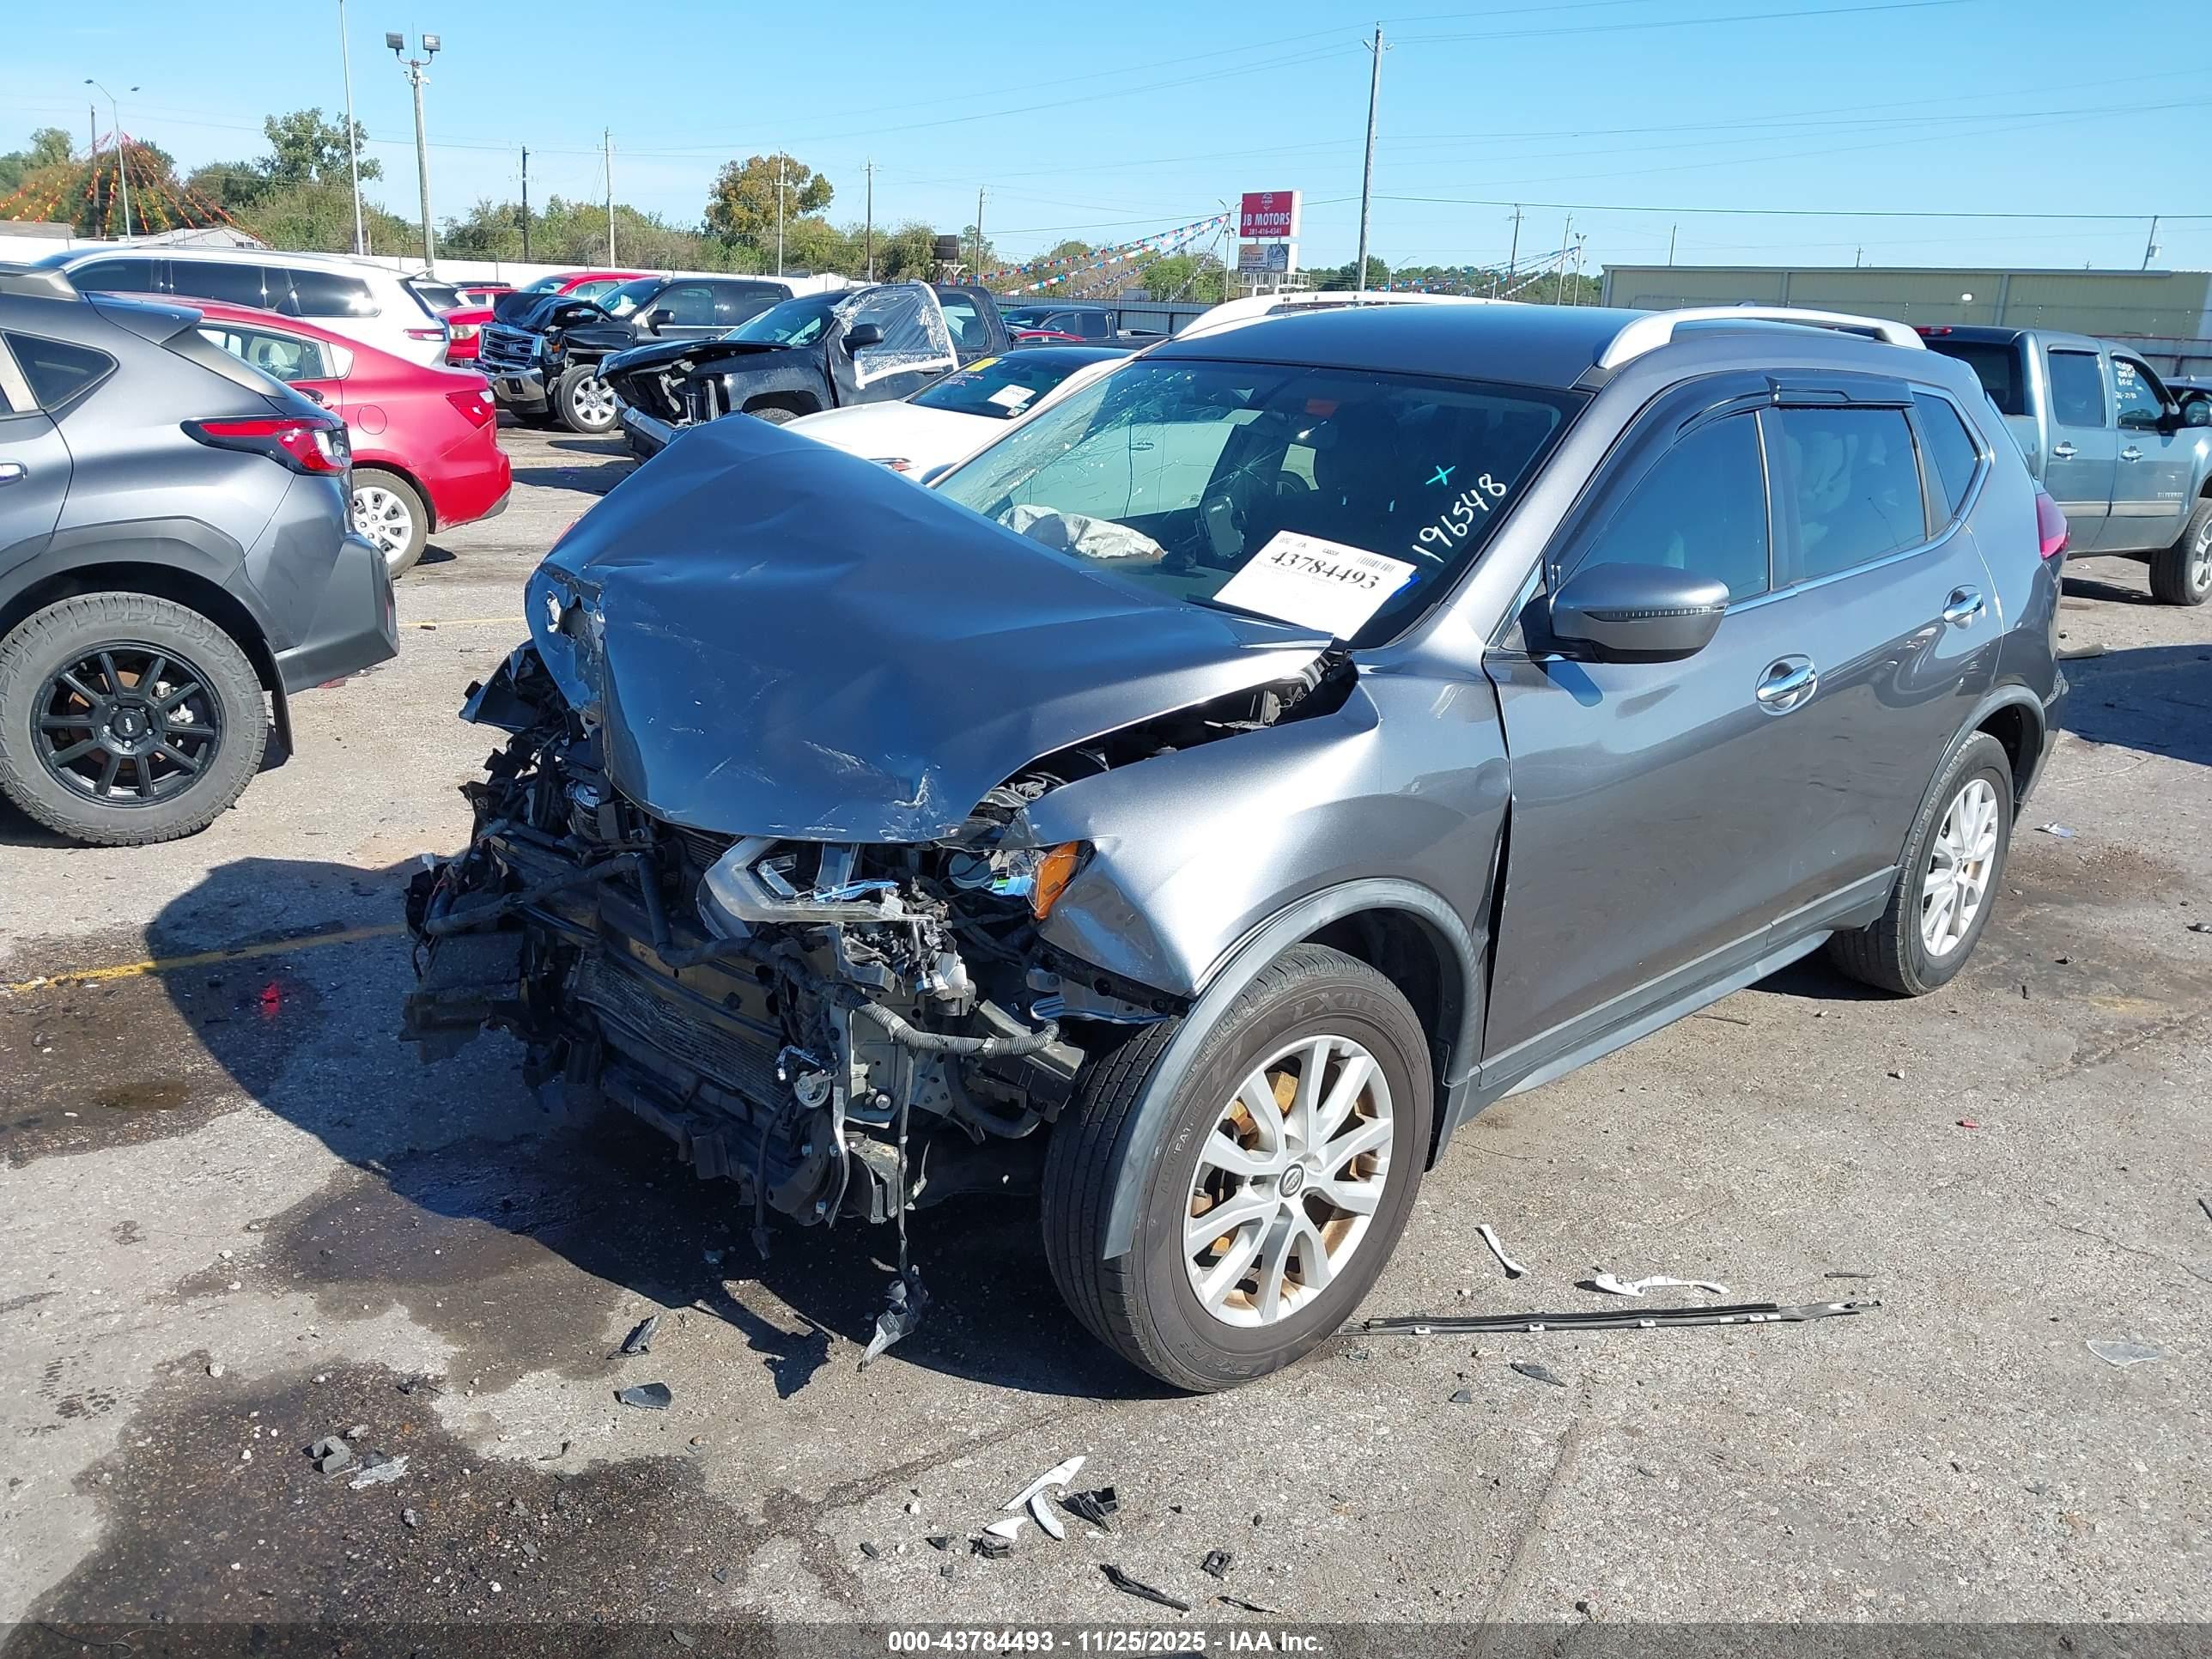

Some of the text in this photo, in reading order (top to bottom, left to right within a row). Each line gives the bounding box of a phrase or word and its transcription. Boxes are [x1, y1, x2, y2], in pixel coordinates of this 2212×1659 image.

[1243, 212, 1291, 227] JB MOTORS
[1412, 473, 1506, 563] 196548
[1270, 550, 1380, 590] 43784493
